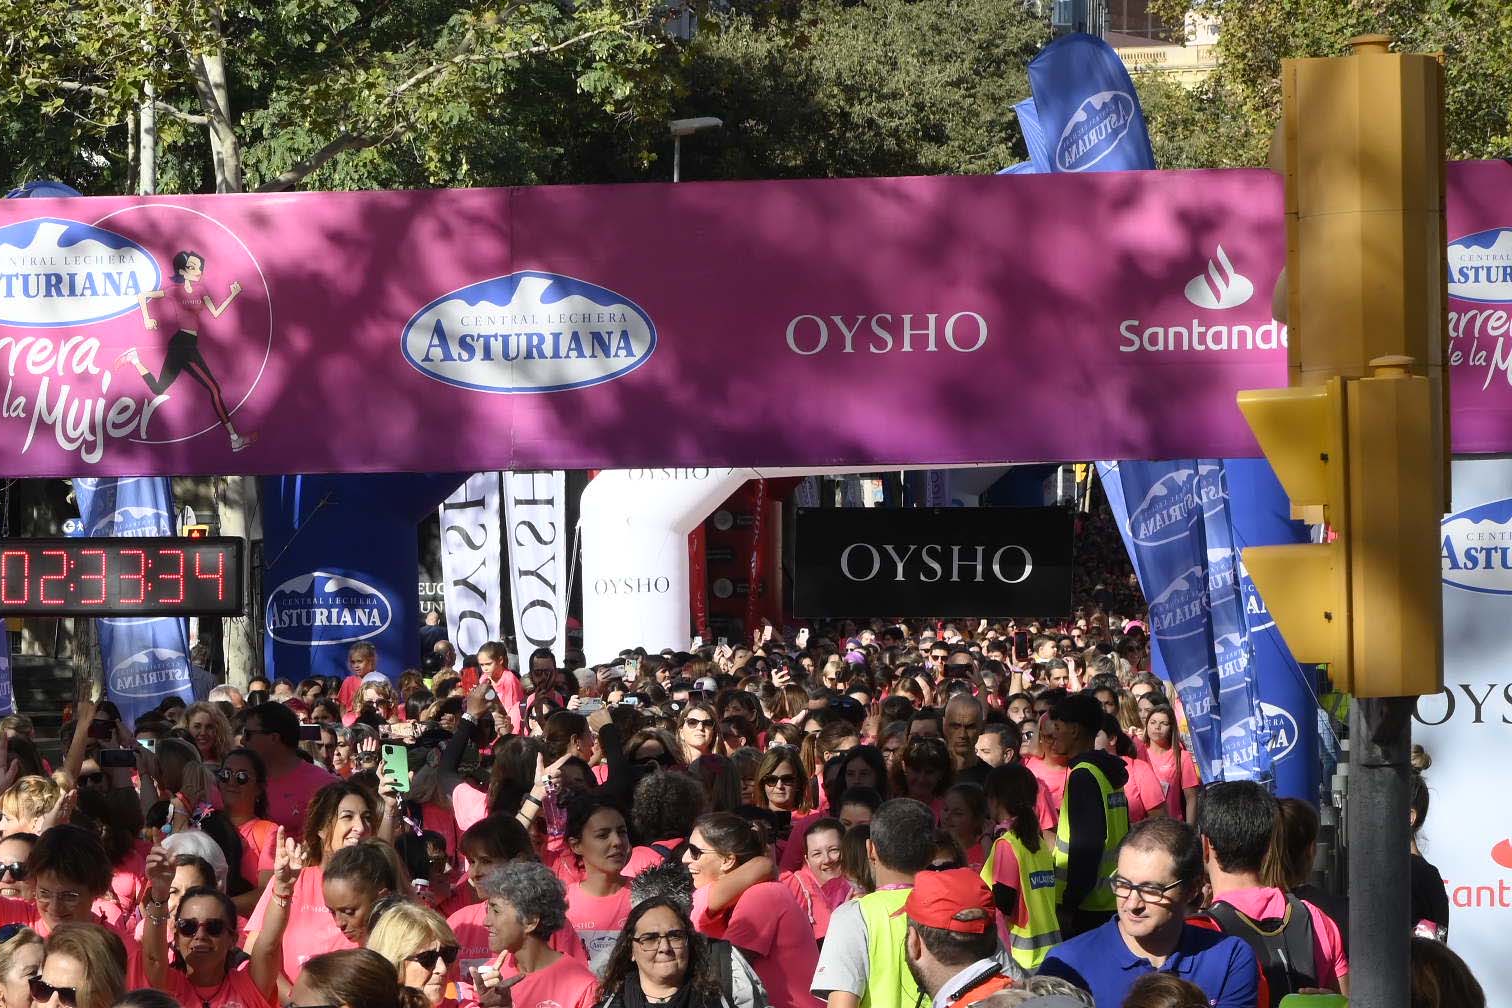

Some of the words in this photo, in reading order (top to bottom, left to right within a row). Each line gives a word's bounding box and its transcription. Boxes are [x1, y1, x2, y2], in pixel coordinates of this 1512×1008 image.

[64, 255, 136, 265] LECHERA
[460, 314, 539, 327] CENTRAL
[547, 312, 629, 325] LECHERA
[785, 311, 987, 355] OYSHO
[422, 319, 636, 363] ASTURIANA
[1469, 338, 1487, 366] la
[2, 380, 26, 418] la
[21, 371, 170, 463] Mujer
[1467, 532, 1512, 541] CENT
[0, 550, 225, 604] 02:33:34
[840, 542, 1034, 584] OYSHO
[594, 576, 670, 596] OYSHO
[270, 601, 382, 629] ASTURIANA
